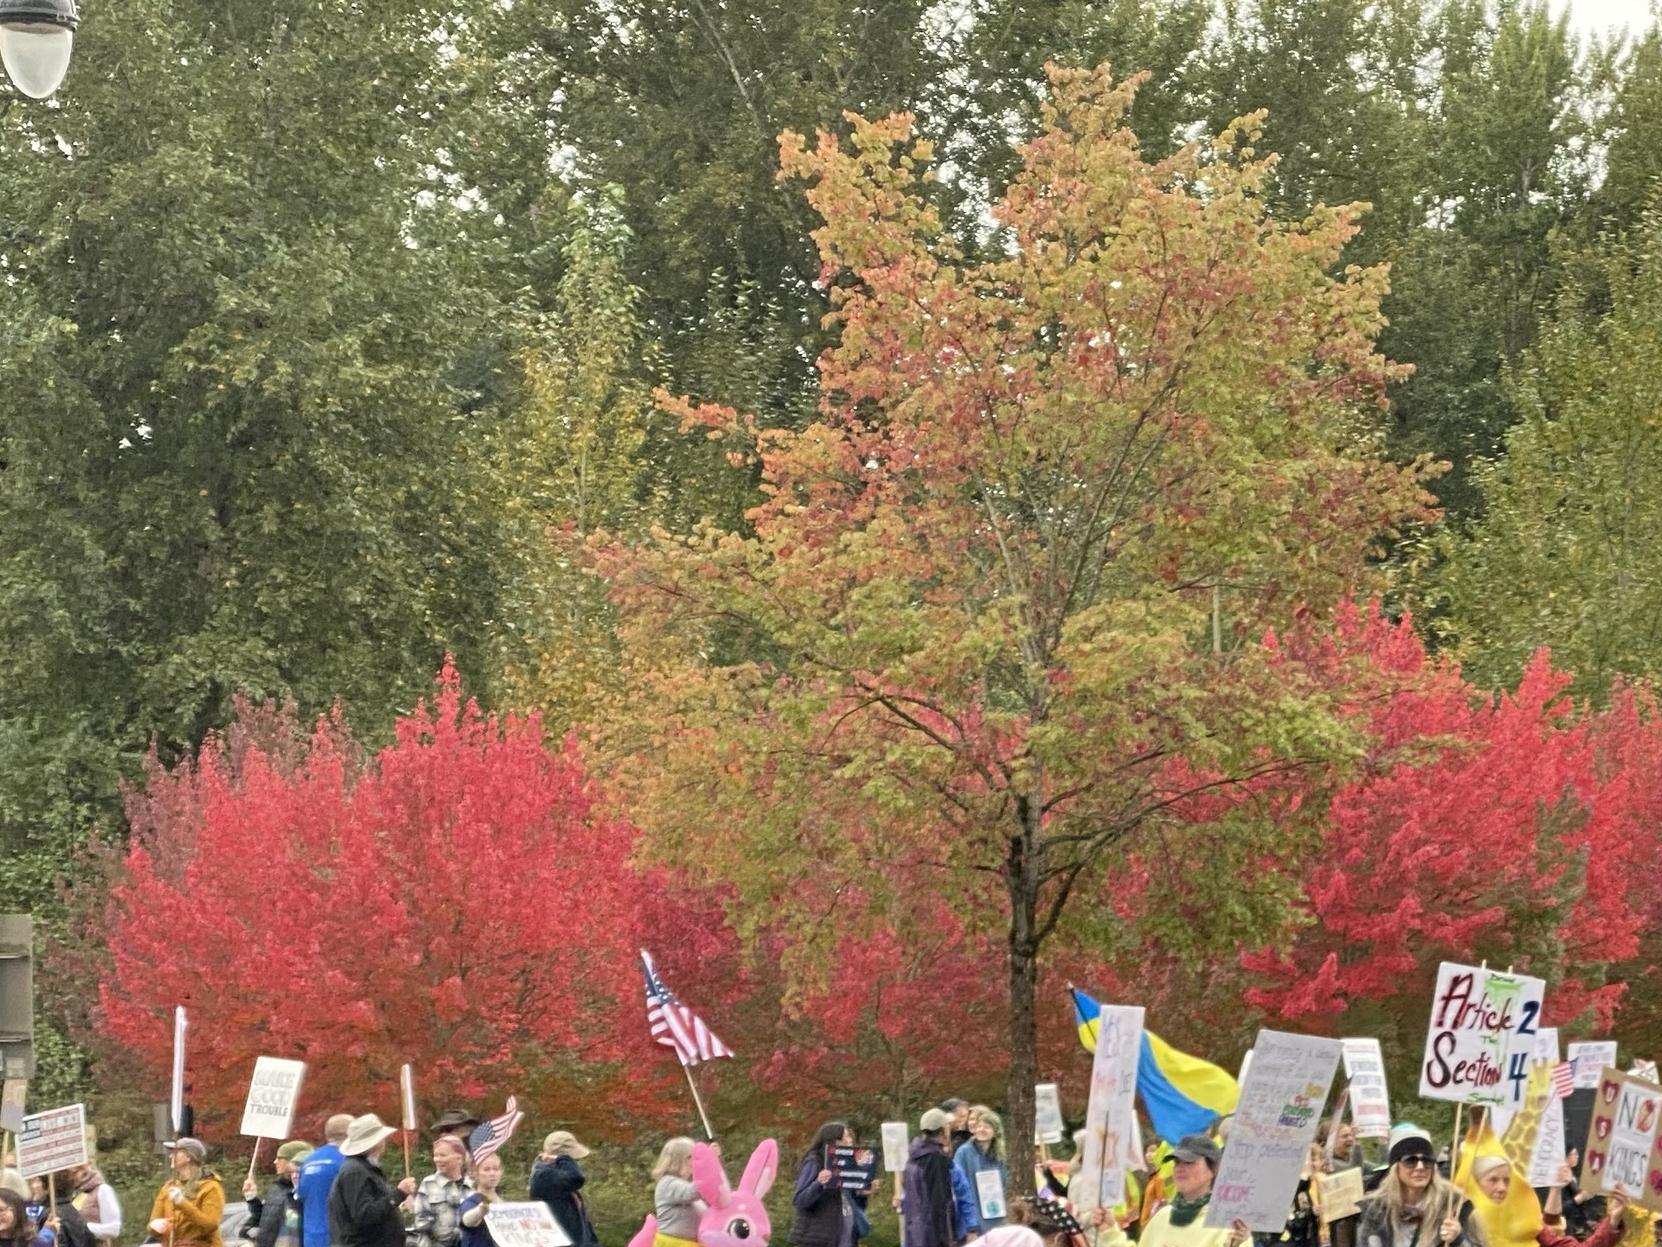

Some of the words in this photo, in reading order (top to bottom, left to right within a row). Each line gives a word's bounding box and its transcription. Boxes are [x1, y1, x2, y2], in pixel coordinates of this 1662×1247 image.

[1437, 973, 1514, 1032] Article
[1516, 1000, 1541, 1035] 2
[1427, 1031, 1503, 1089] Section
[1508, 1052, 1528, 1102] 4
[250, 1103, 289, 1117] TROUBLE
